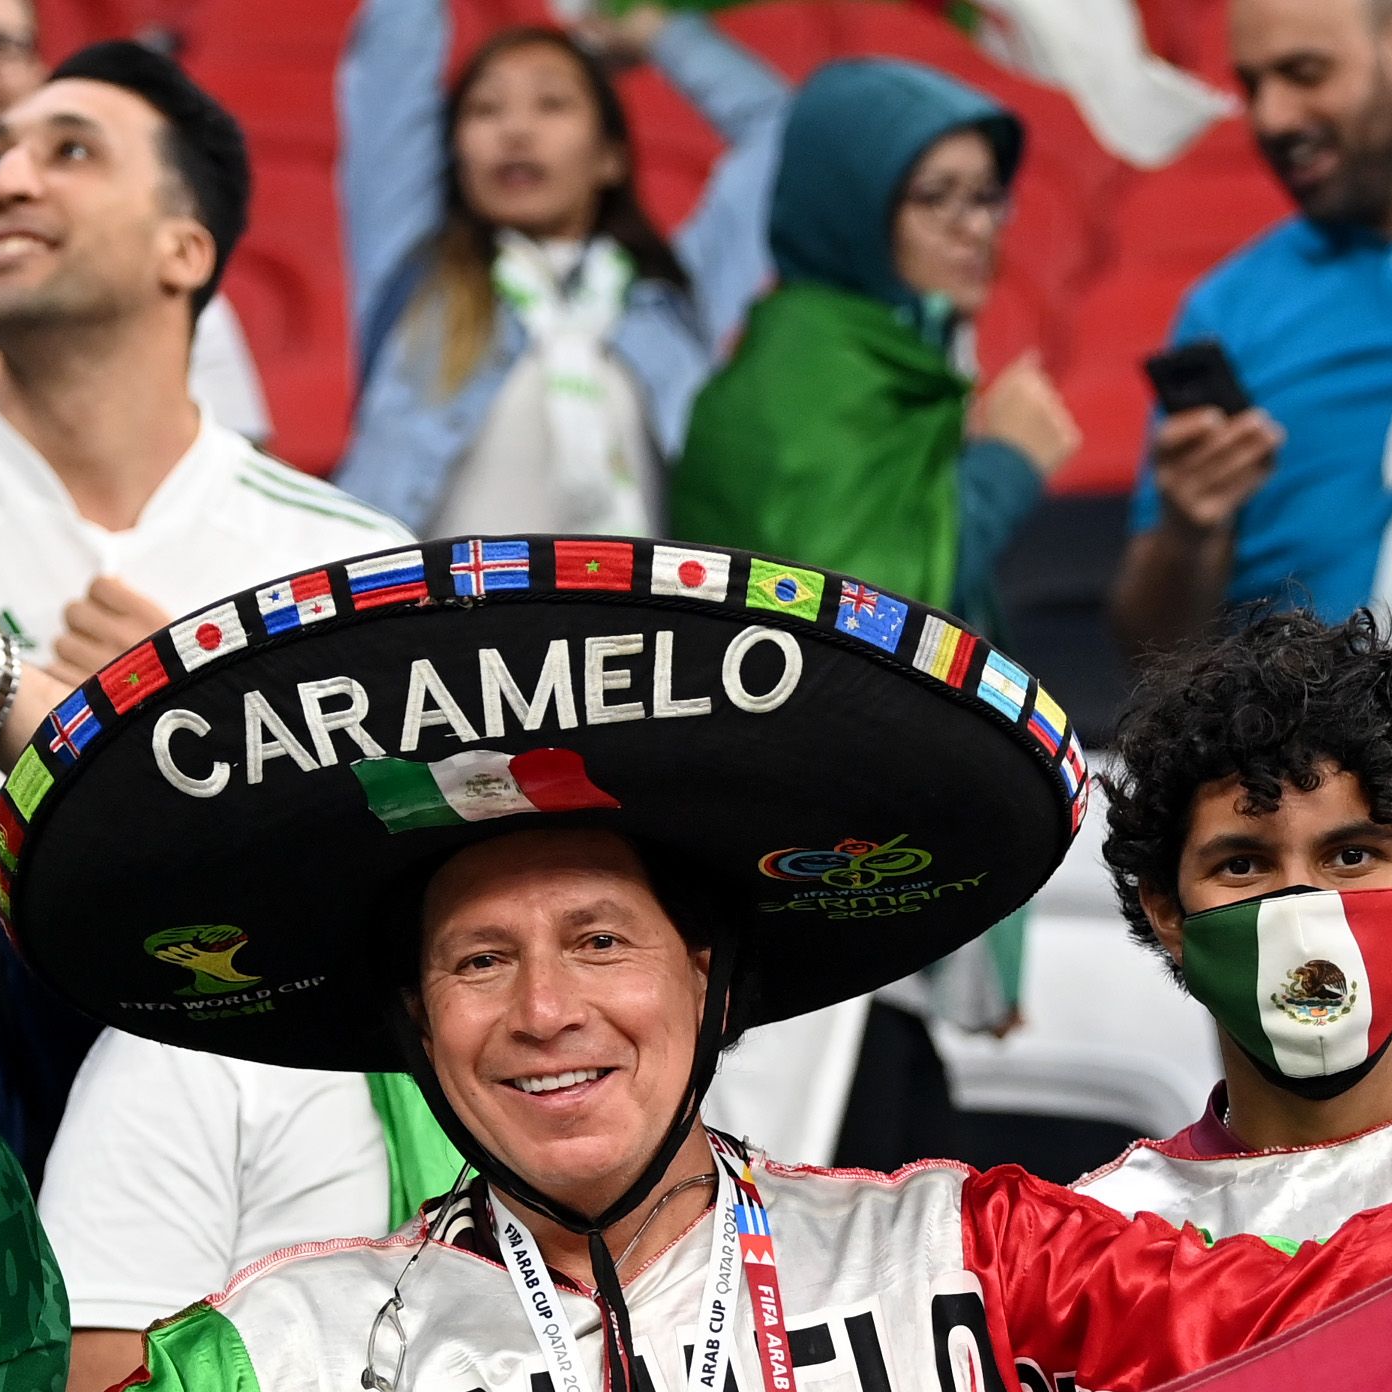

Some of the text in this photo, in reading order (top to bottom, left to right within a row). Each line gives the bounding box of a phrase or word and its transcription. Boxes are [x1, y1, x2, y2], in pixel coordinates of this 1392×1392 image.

[152, 625, 803, 799] CARAMELO
[827, 904, 922, 919] 2006
[182, 989, 272, 1010] WORLD
[278, 975, 326, 993] CUP
[504, 1222, 524, 1248] FIFA
[723, 1206, 737, 1243] 2021
[513, 1250, 540, 1290] ARAB
[715, 1245, 736, 1295] QATAR
[531, 1291, 553, 1320] CUP
[709, 1299, 727, 1334] CUP
[757, 1284, 780, 1327] FIFA
[542, 1323, 573, 1372] QATAR
[701, 1339, 721, 1389] ARAB
[766, 1332, 791, 1391] ARAB
